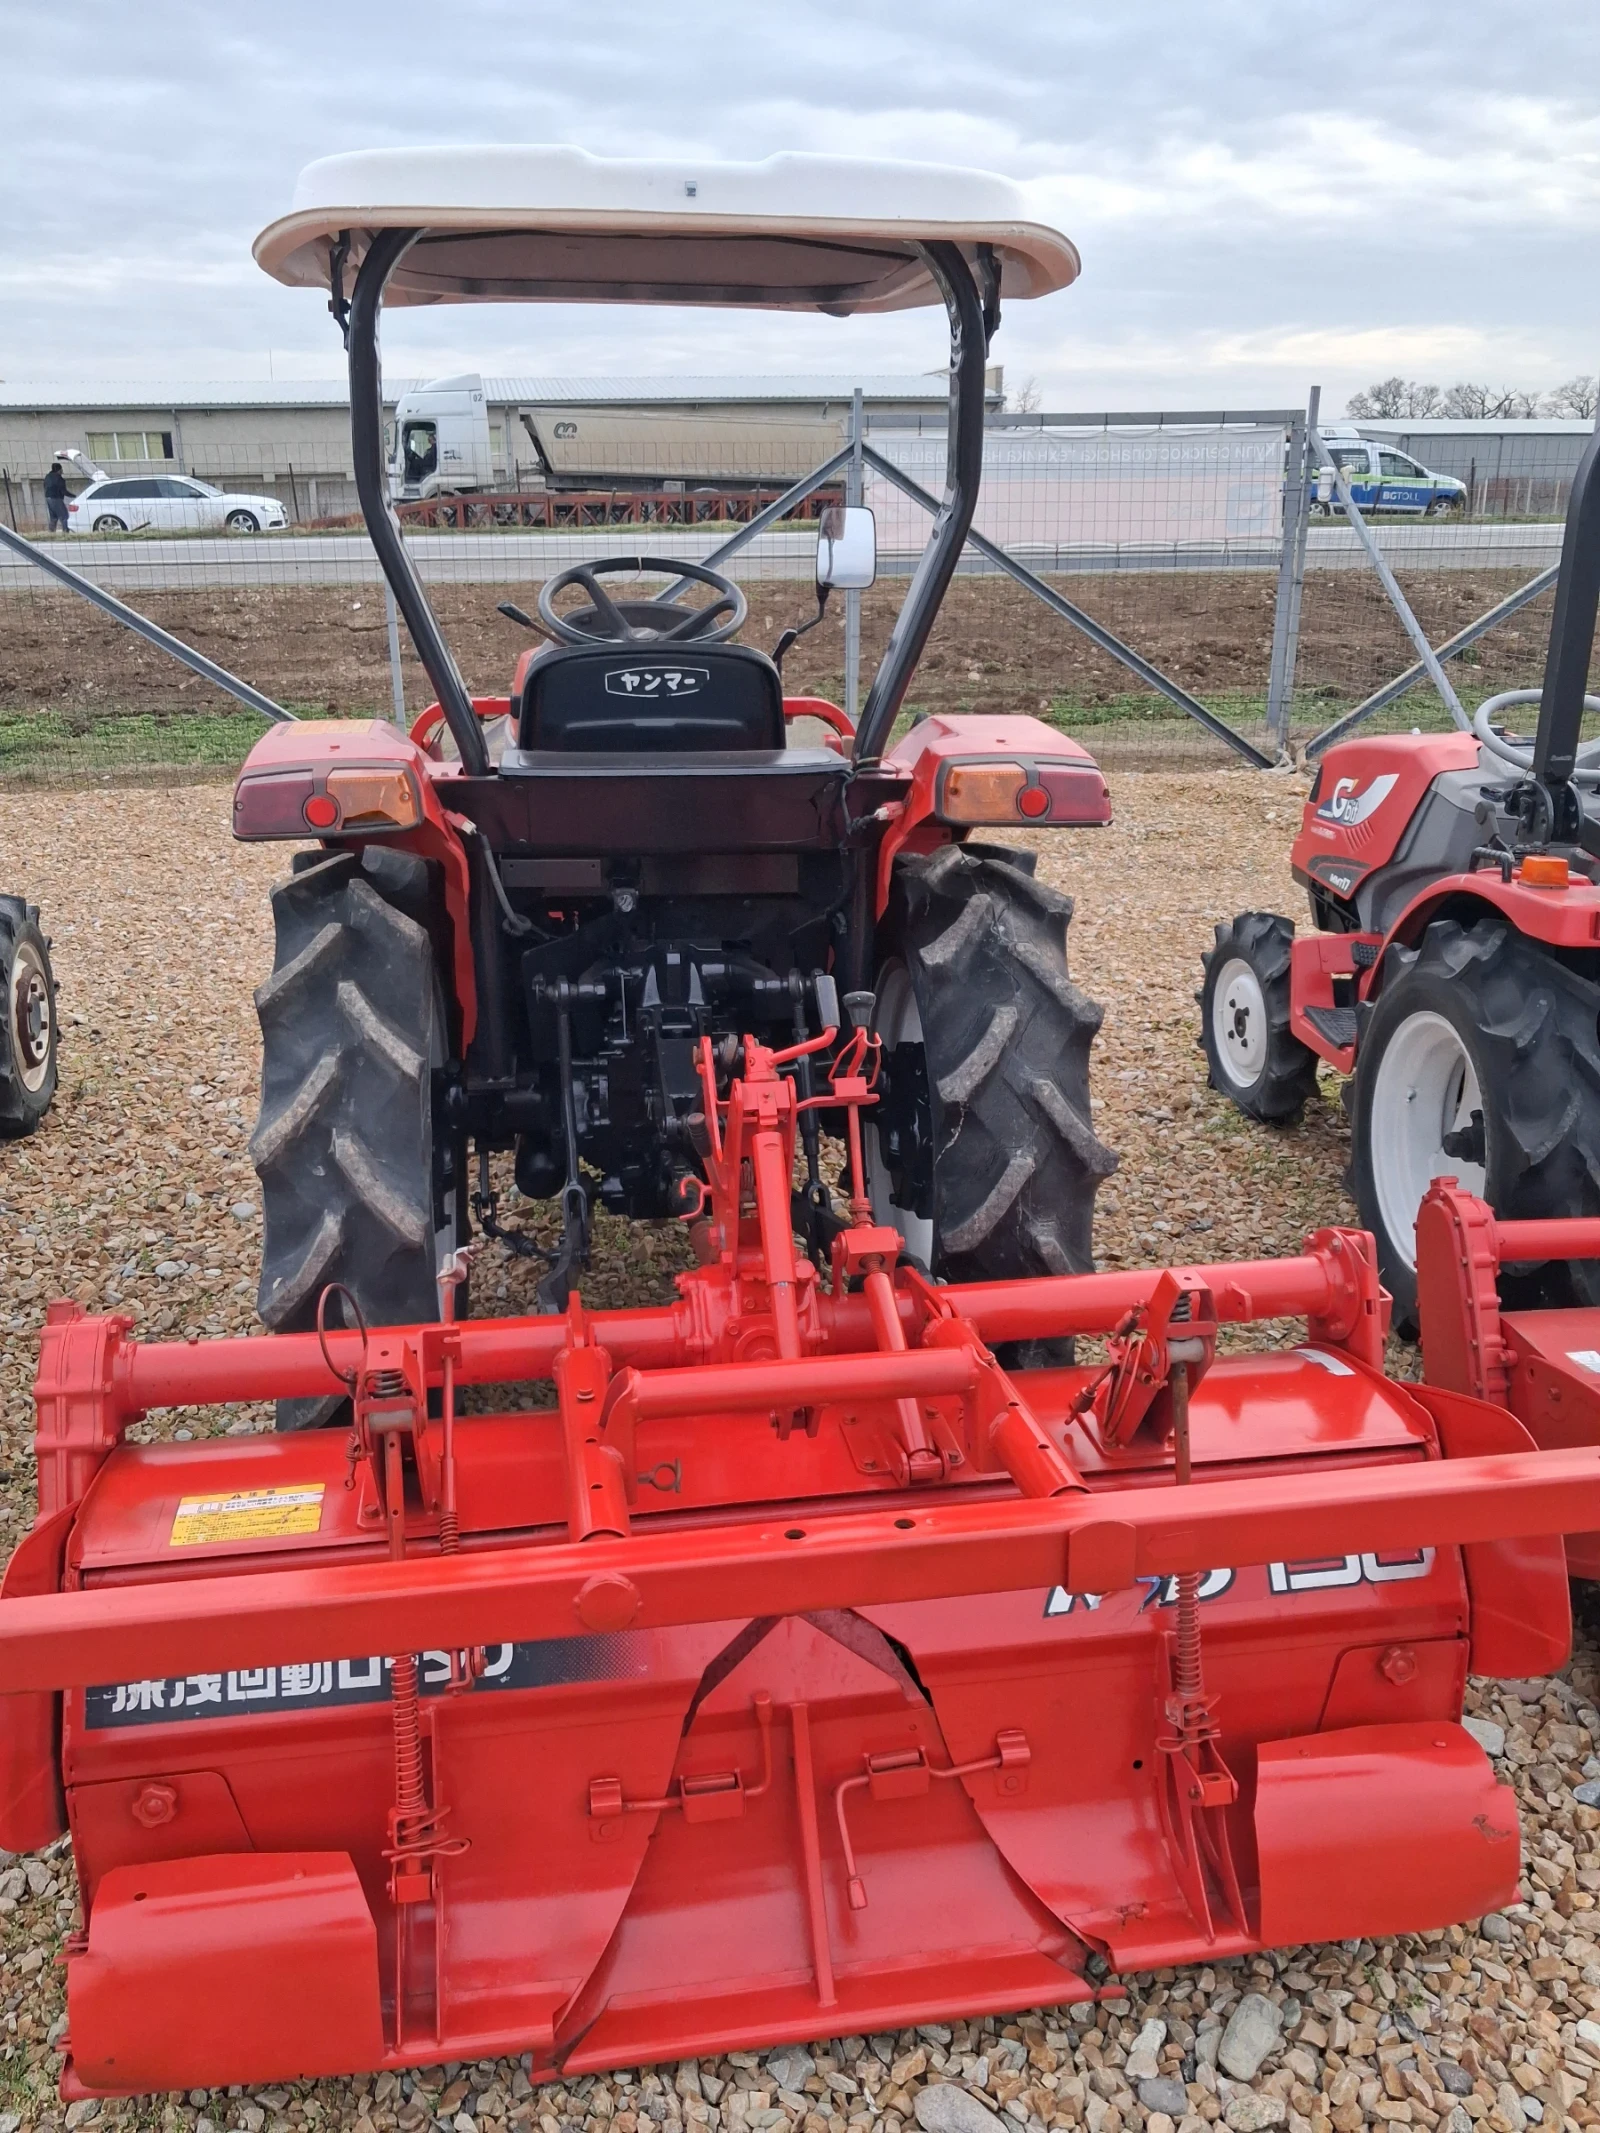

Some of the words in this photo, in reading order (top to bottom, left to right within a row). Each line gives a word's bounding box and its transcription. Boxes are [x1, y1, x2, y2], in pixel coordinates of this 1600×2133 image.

[473, 393, 483, 402] 02
[1382, 491, 1420, 501] BGTOLL
[621, 673, 696, 692] ヤンマー
